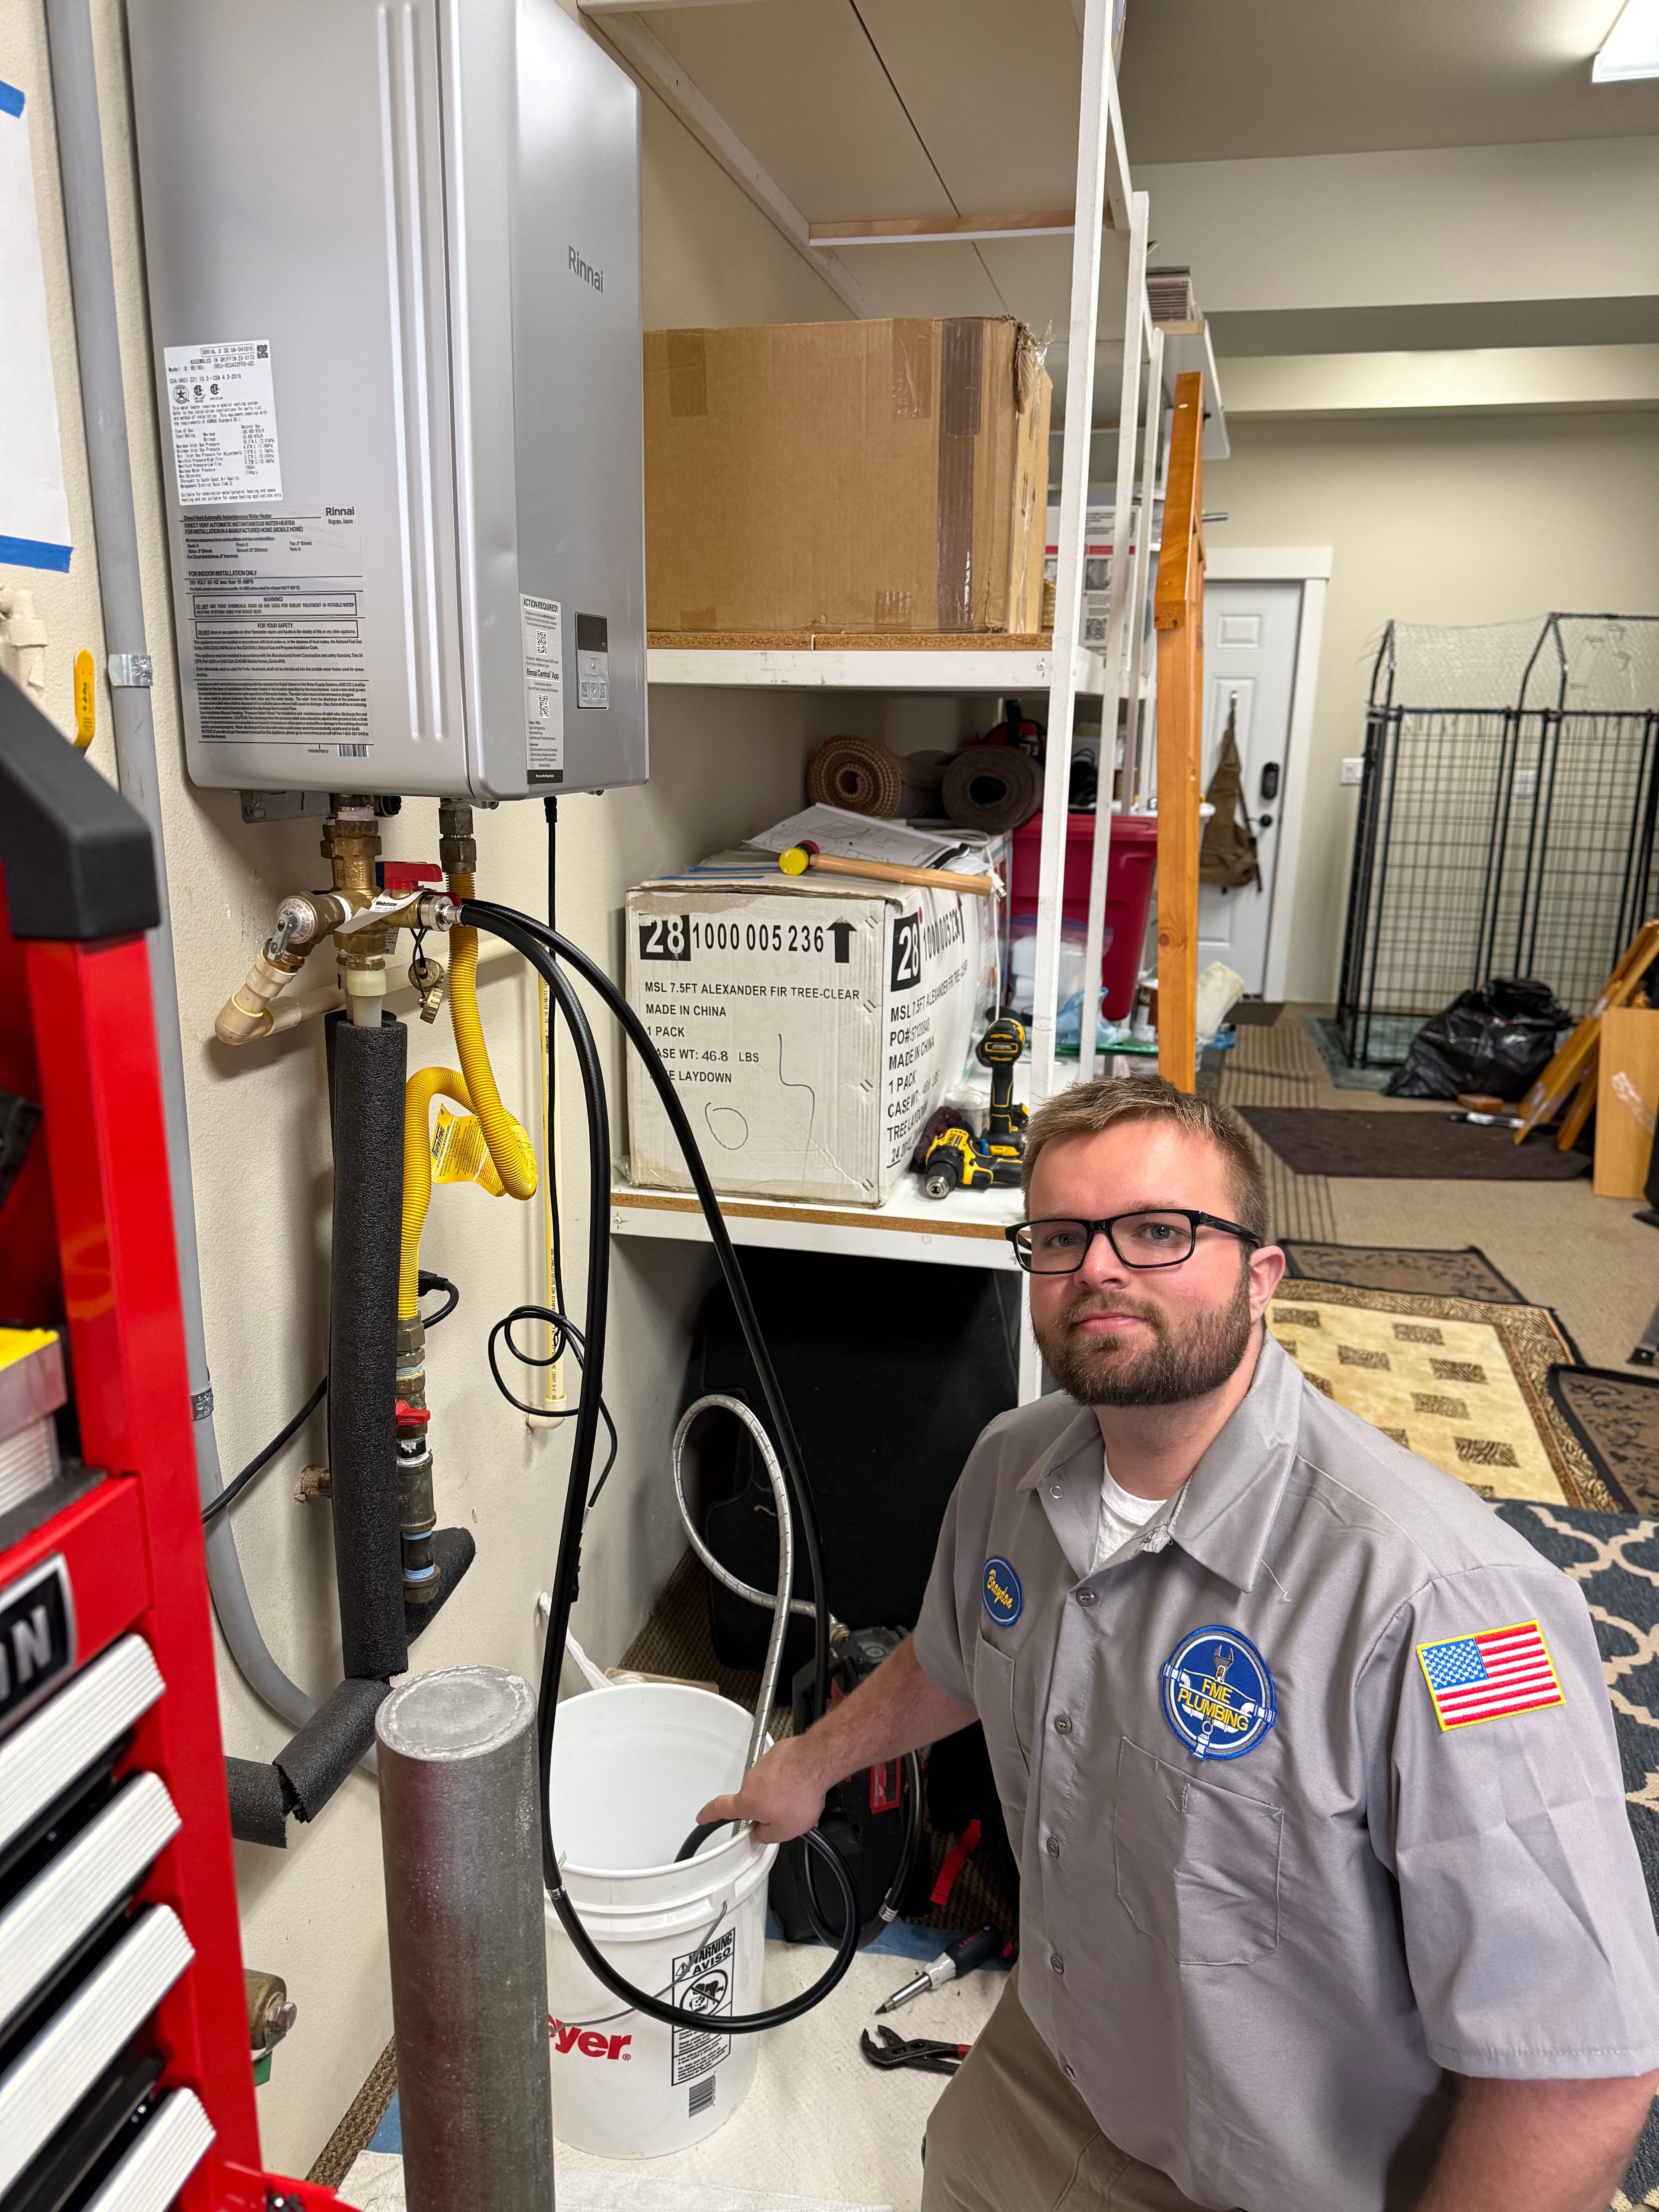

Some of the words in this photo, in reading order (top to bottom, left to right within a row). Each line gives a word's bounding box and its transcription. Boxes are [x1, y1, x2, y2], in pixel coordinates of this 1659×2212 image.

[569, 245, 603, 293] Rinnai
[326, 507, 355, 516] Rinnai
[646, 914, 684, 954] 28
[692, 922, 740, 950] 1000
[746, 924, 782, 952] 005
[788, 925, 824, 953] 236
[897, 922, 919, 981] 28
[645, 982, 667, 993] MSL
[670, 983, 698, 994] 7.5FT
[701, 984, 767, 996] ALEXANDER
[771, 987, 787, 997] FIR
[791, 988, 859, 1000] TREE-CLEAR
[646, 1004, 677, 1015] MADE
[680, 1005, 690, 1015] IN
[693, 1005, 727, 1017] CHINA
[891, 1004, 911, 1022] MSL
[912, 995, 925, 1016] 7.5FT
[647, 1027, 652, 1036] 1
[656, 1027, 685, 1037] PACK
[657, 1049, 676, 1059] ASE
[679, 1049, 698, 1059] WT:
[702, 1051, 728, 1062] 46.8
[739, 1052, 759, 1062] LBS
[889, 1049, 914, 1071] MADE
[915, 1044, 920, 1061] IN
[921, 1035, 934, 1056] CHINA
[679, 1071, 732, 1083] LAYDOWN
[889, 1079, 893, 1094] 1
[897, 1069, 916, 1092] PACK
[888, 1096, 910, 1118] CASE
[911, 1089, 920, 1107] WT:
[433, 1127, 444, 1157] DuraTrac
[887, 1119, 908, 1142] TREE
[986, 1569, 1014, 1610] Braydon
[1201, 1678, 1233, 1704] FME
[1177, 1688, 1249, 1731] PLUMBING
[689, 1932, 732, 1964] WARNING
[693, 1947, 731, 1975] AVISO
